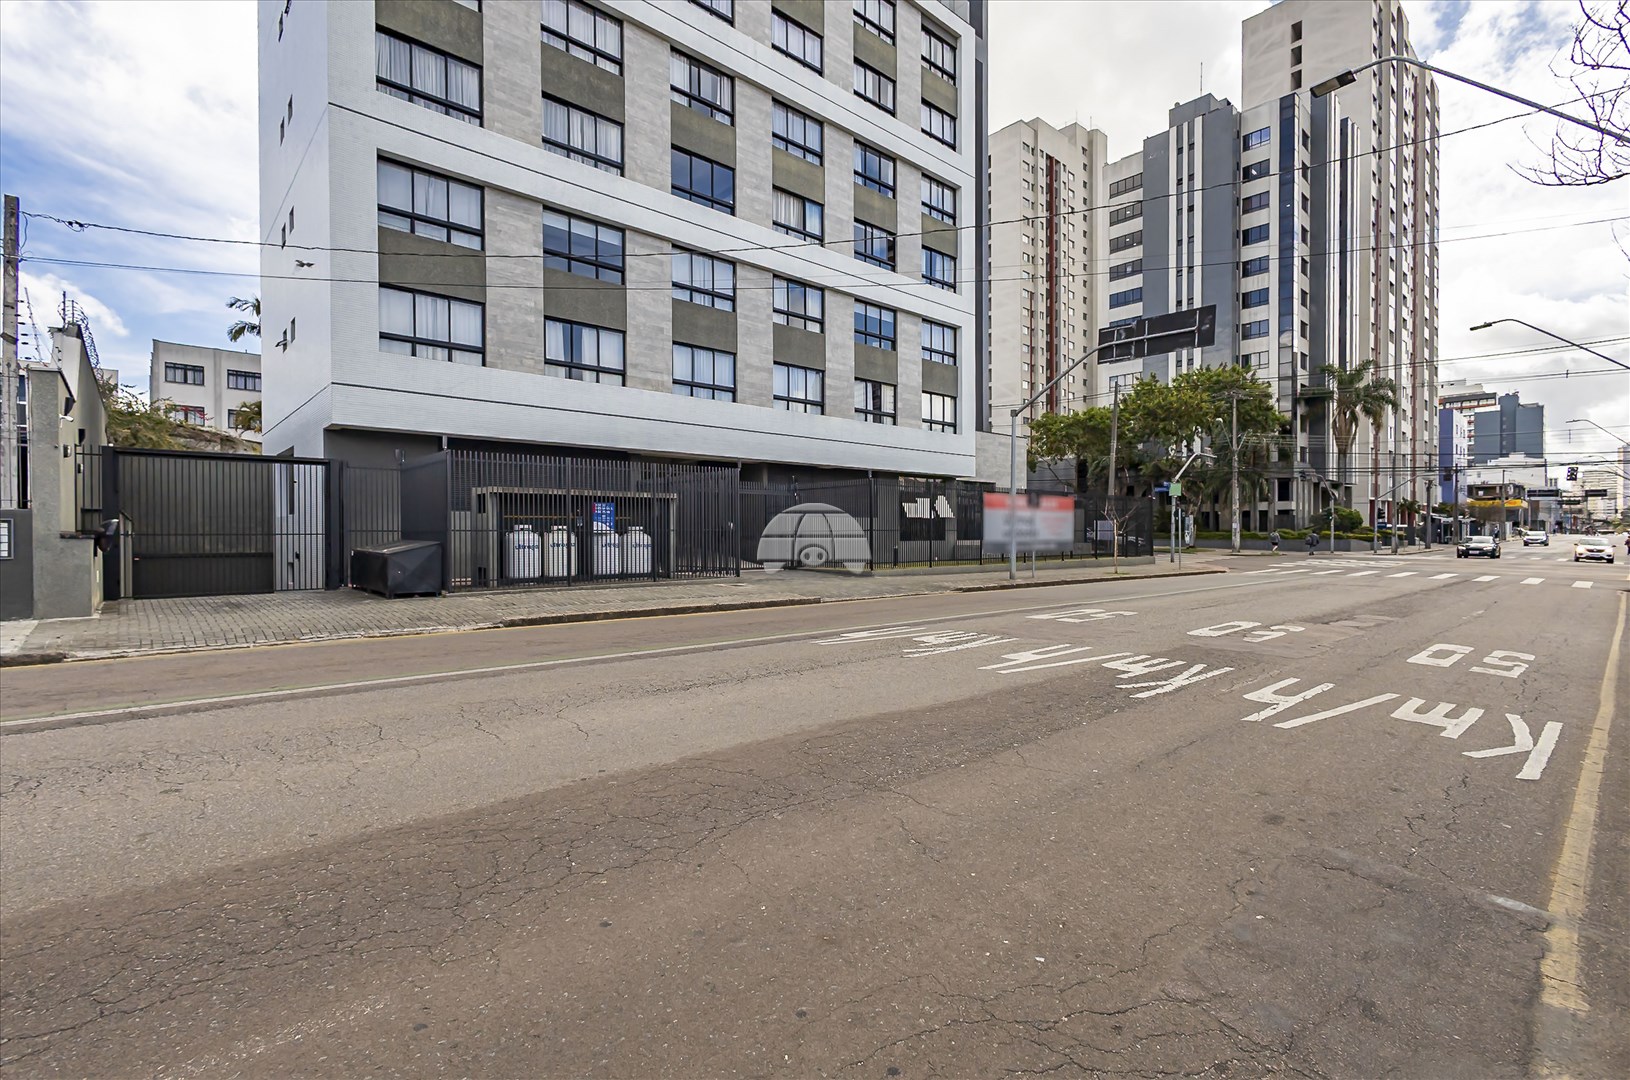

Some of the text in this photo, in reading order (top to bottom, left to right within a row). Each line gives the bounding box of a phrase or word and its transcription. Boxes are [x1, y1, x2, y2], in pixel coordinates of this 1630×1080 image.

[1025, 608, 1138, 623] 50
[1187, 620, 1306, 643] 50
[1407, 643, 1536, 679] 50
[1240, 677, 1564, 780] Km/h
